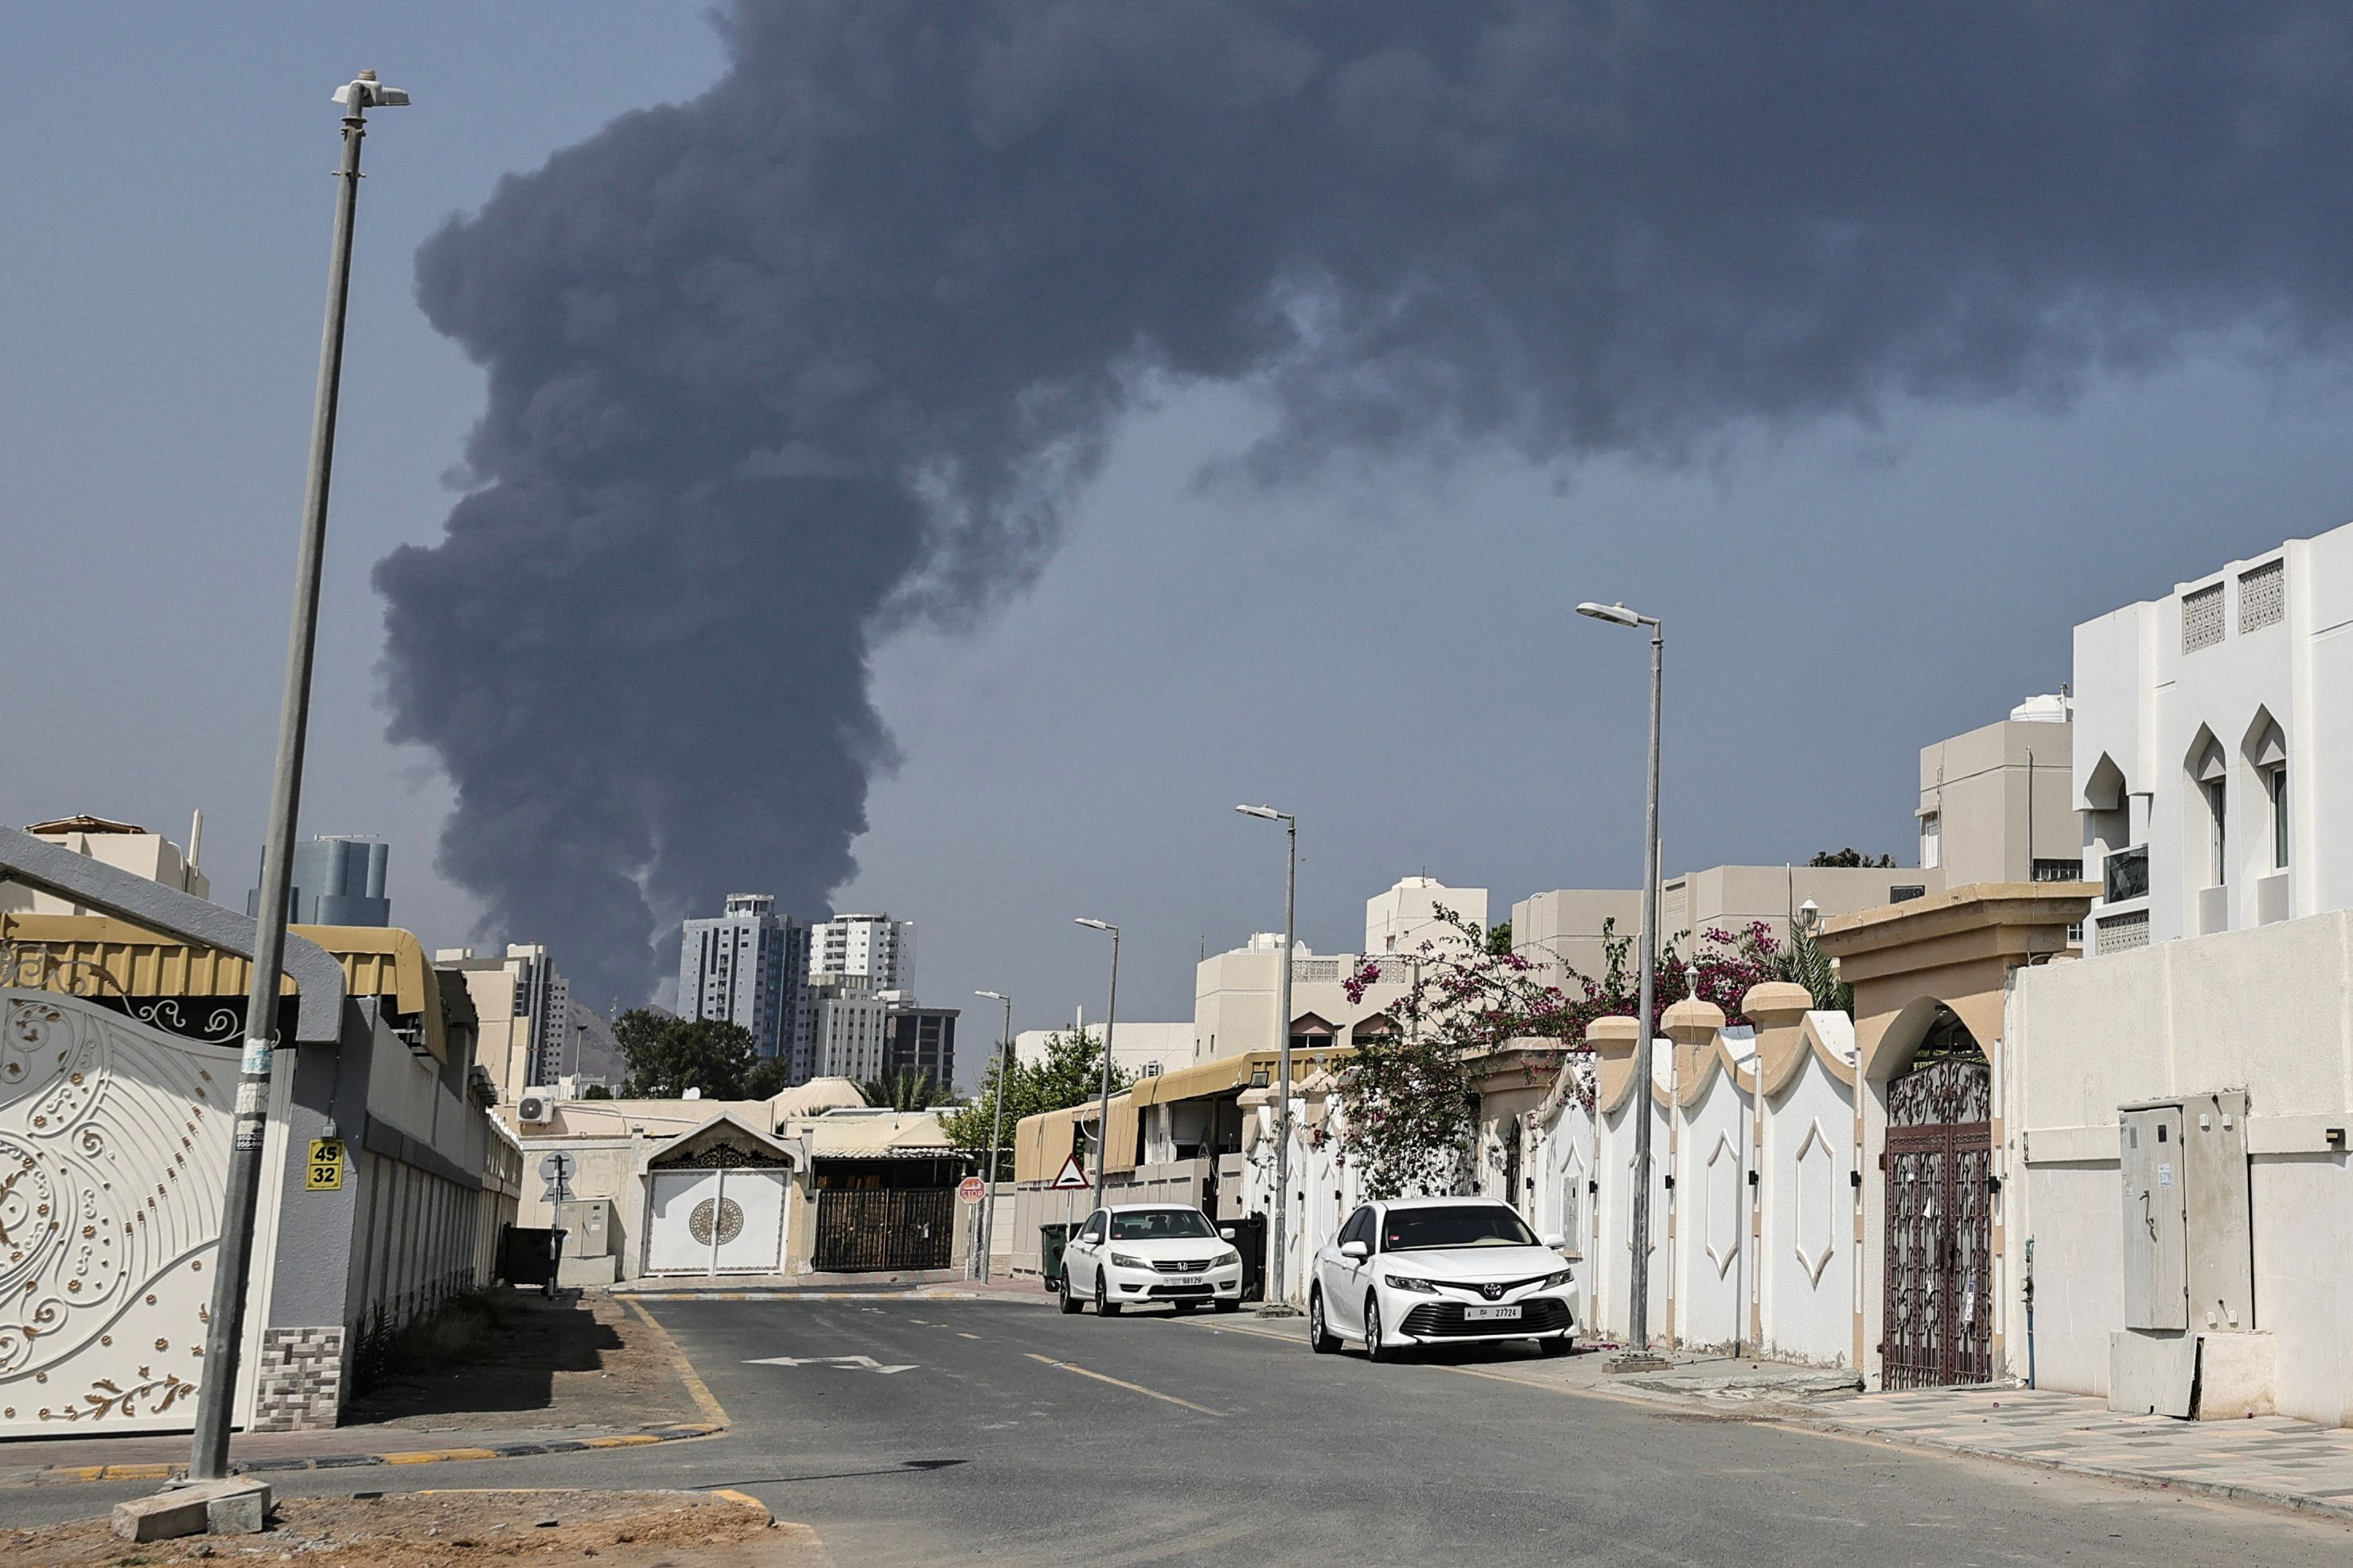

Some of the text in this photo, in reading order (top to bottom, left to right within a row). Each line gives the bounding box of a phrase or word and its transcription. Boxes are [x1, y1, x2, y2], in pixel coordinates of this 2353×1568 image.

[314, 1146, 337, 1161] 45
[313, 1167, 335, 1183] 32
[1496, 1308, 1516, 1317] 27724
